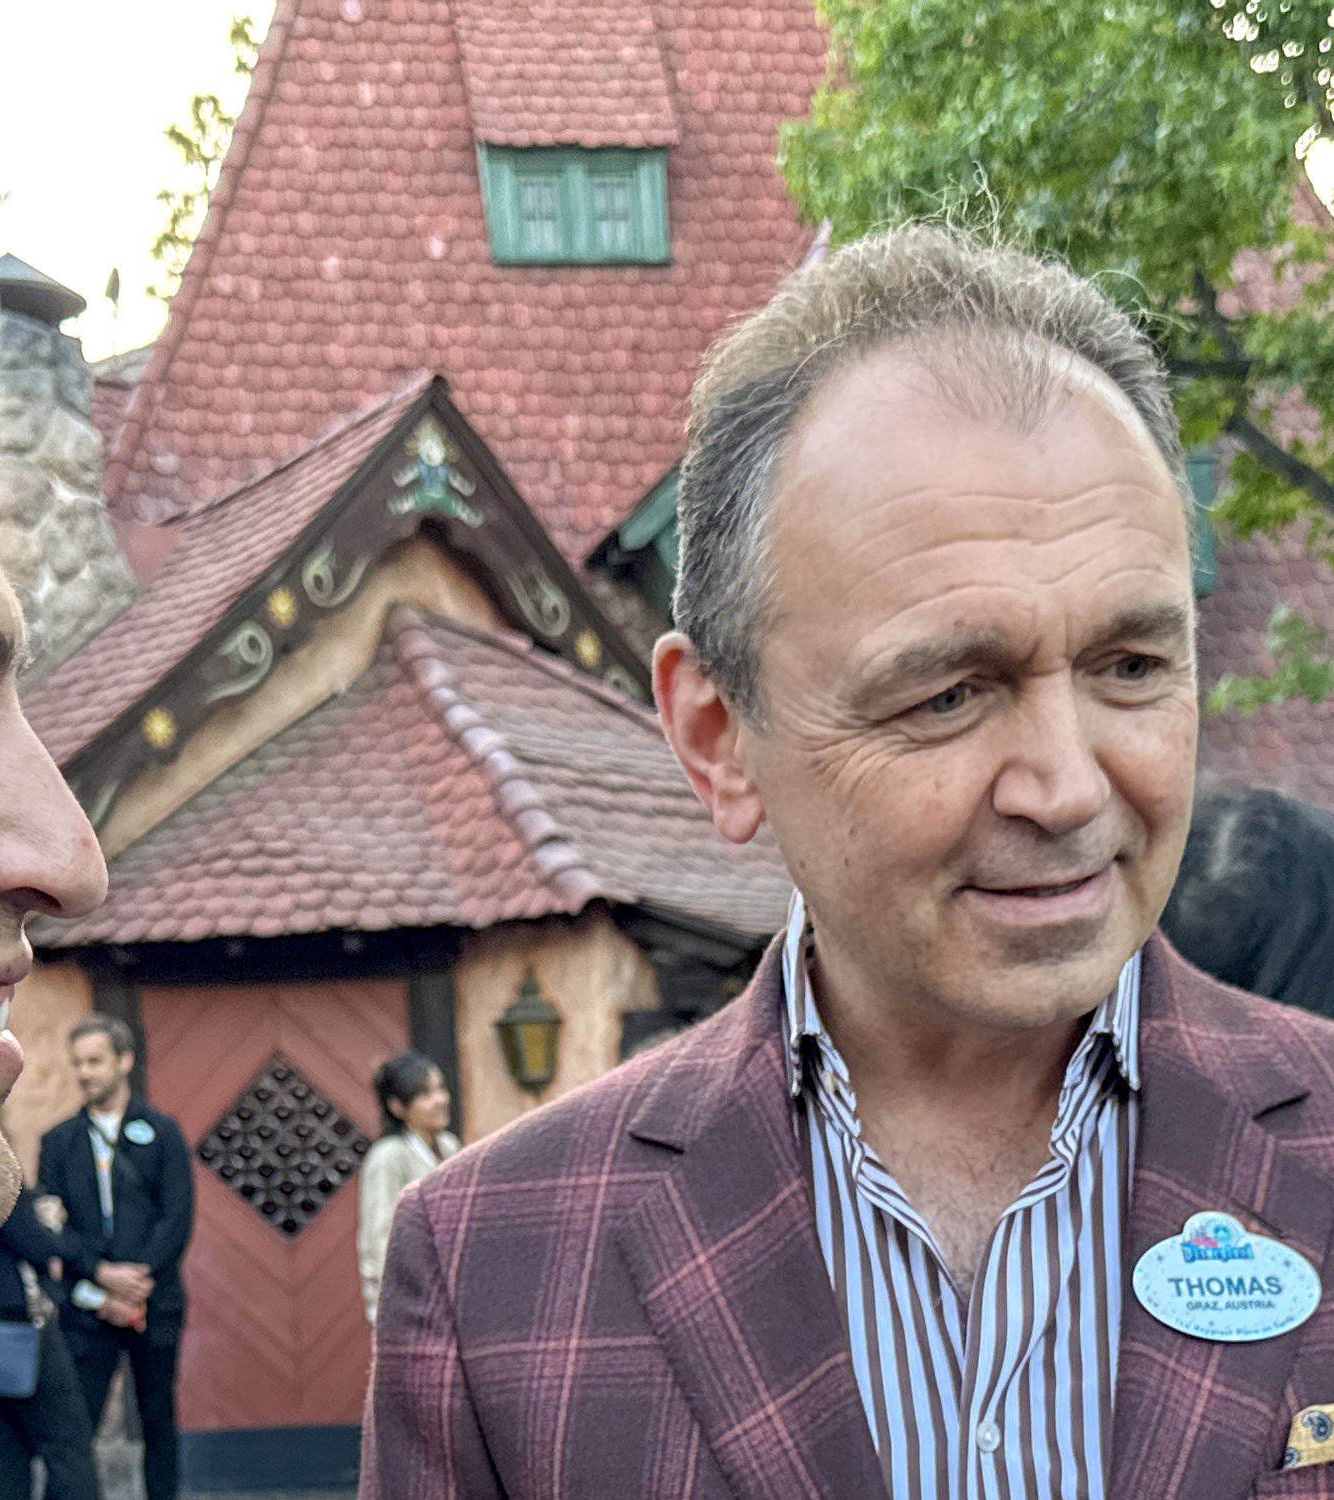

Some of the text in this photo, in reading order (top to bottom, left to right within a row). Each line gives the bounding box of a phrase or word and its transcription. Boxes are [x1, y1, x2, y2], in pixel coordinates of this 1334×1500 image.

[1168, 1276, 1282, 1297] THOMAS
[1186, 1301, 1275, 1312] GRAZ, AUSTRIA
